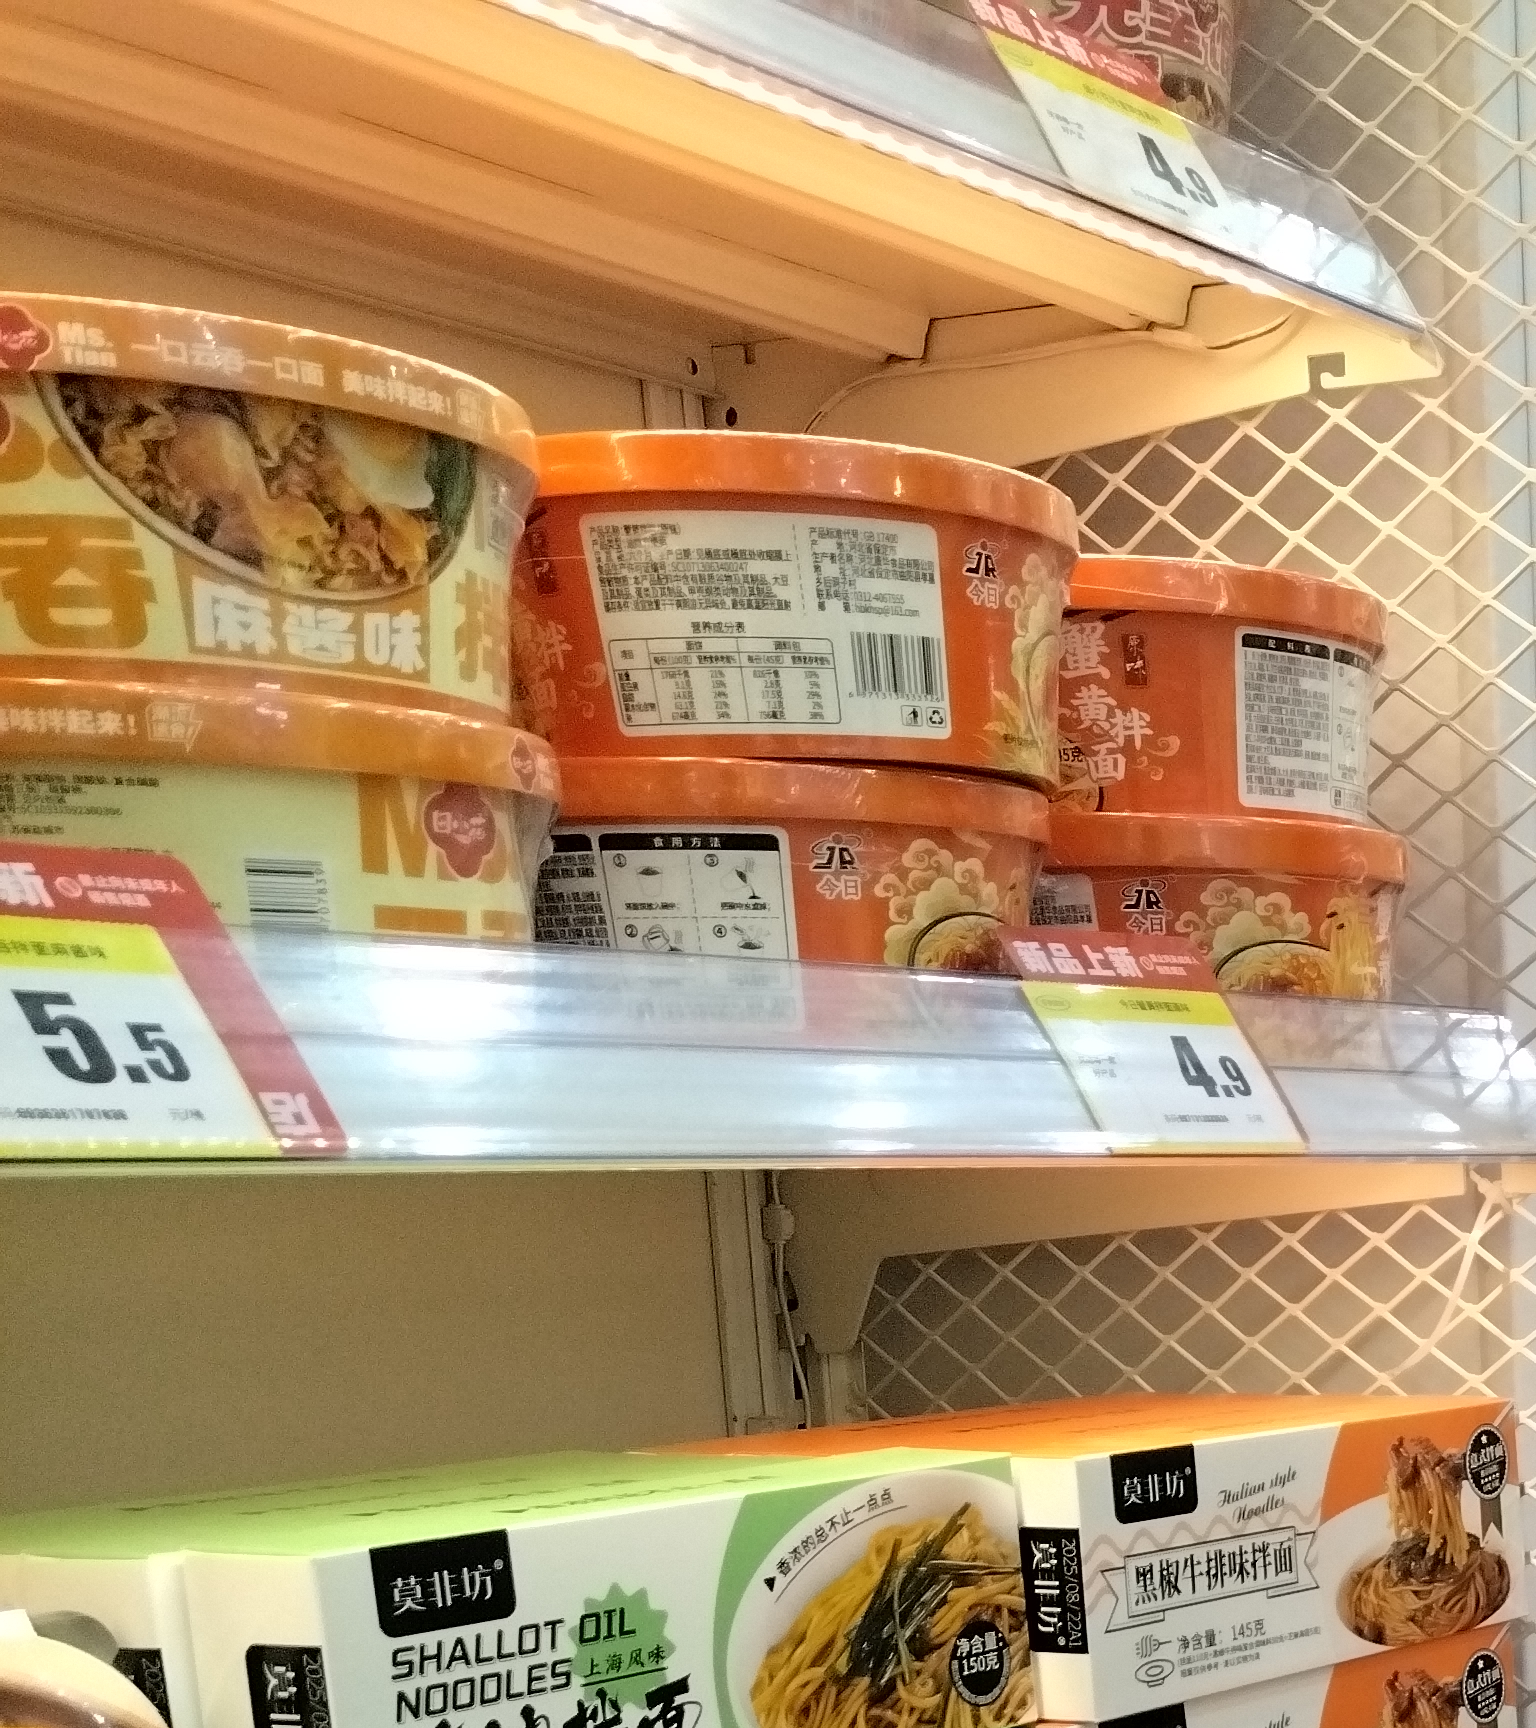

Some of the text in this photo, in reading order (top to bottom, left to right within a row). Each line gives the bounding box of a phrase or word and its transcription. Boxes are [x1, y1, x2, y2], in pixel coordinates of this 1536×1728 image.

[1137, 132, 1218, 208] 4.9
[58, 321, 114, 348] Ms.
[965, 578, 1001, 610] 今日
[191, 574, 426, 674] 麻酱味
[652, 834, 724, 851] 食用方法
[815, 872, 864, 901] 今日
[1125, 914, 1166, 934] 今日
[1011, 940, 1144, 978] 新品上新
[11, 987, 192, 1084] 5.5
[1169, 1034, 1252, 1098] 4.9
[1123, 1470, 1185, 1507] 莫非坊
[1216, 1465, 1298, 1509] Italian style
[1231, 1493, 1286, 1524] Noodles
[1133, 1535, 1295, 1607] 黑椒牛排味拌面
[390, 1564, 495, 1617] 莫非坊
[390, 1606, 637, 1682] SHALLOT OIL
[1230, 1617, 1267, 1642] 145克
[580, 1643, 670, 1679] 上海风味
[961, 1652, 1001, 1676] 150克
[396, 1658, 575, 1723] NOODLES
